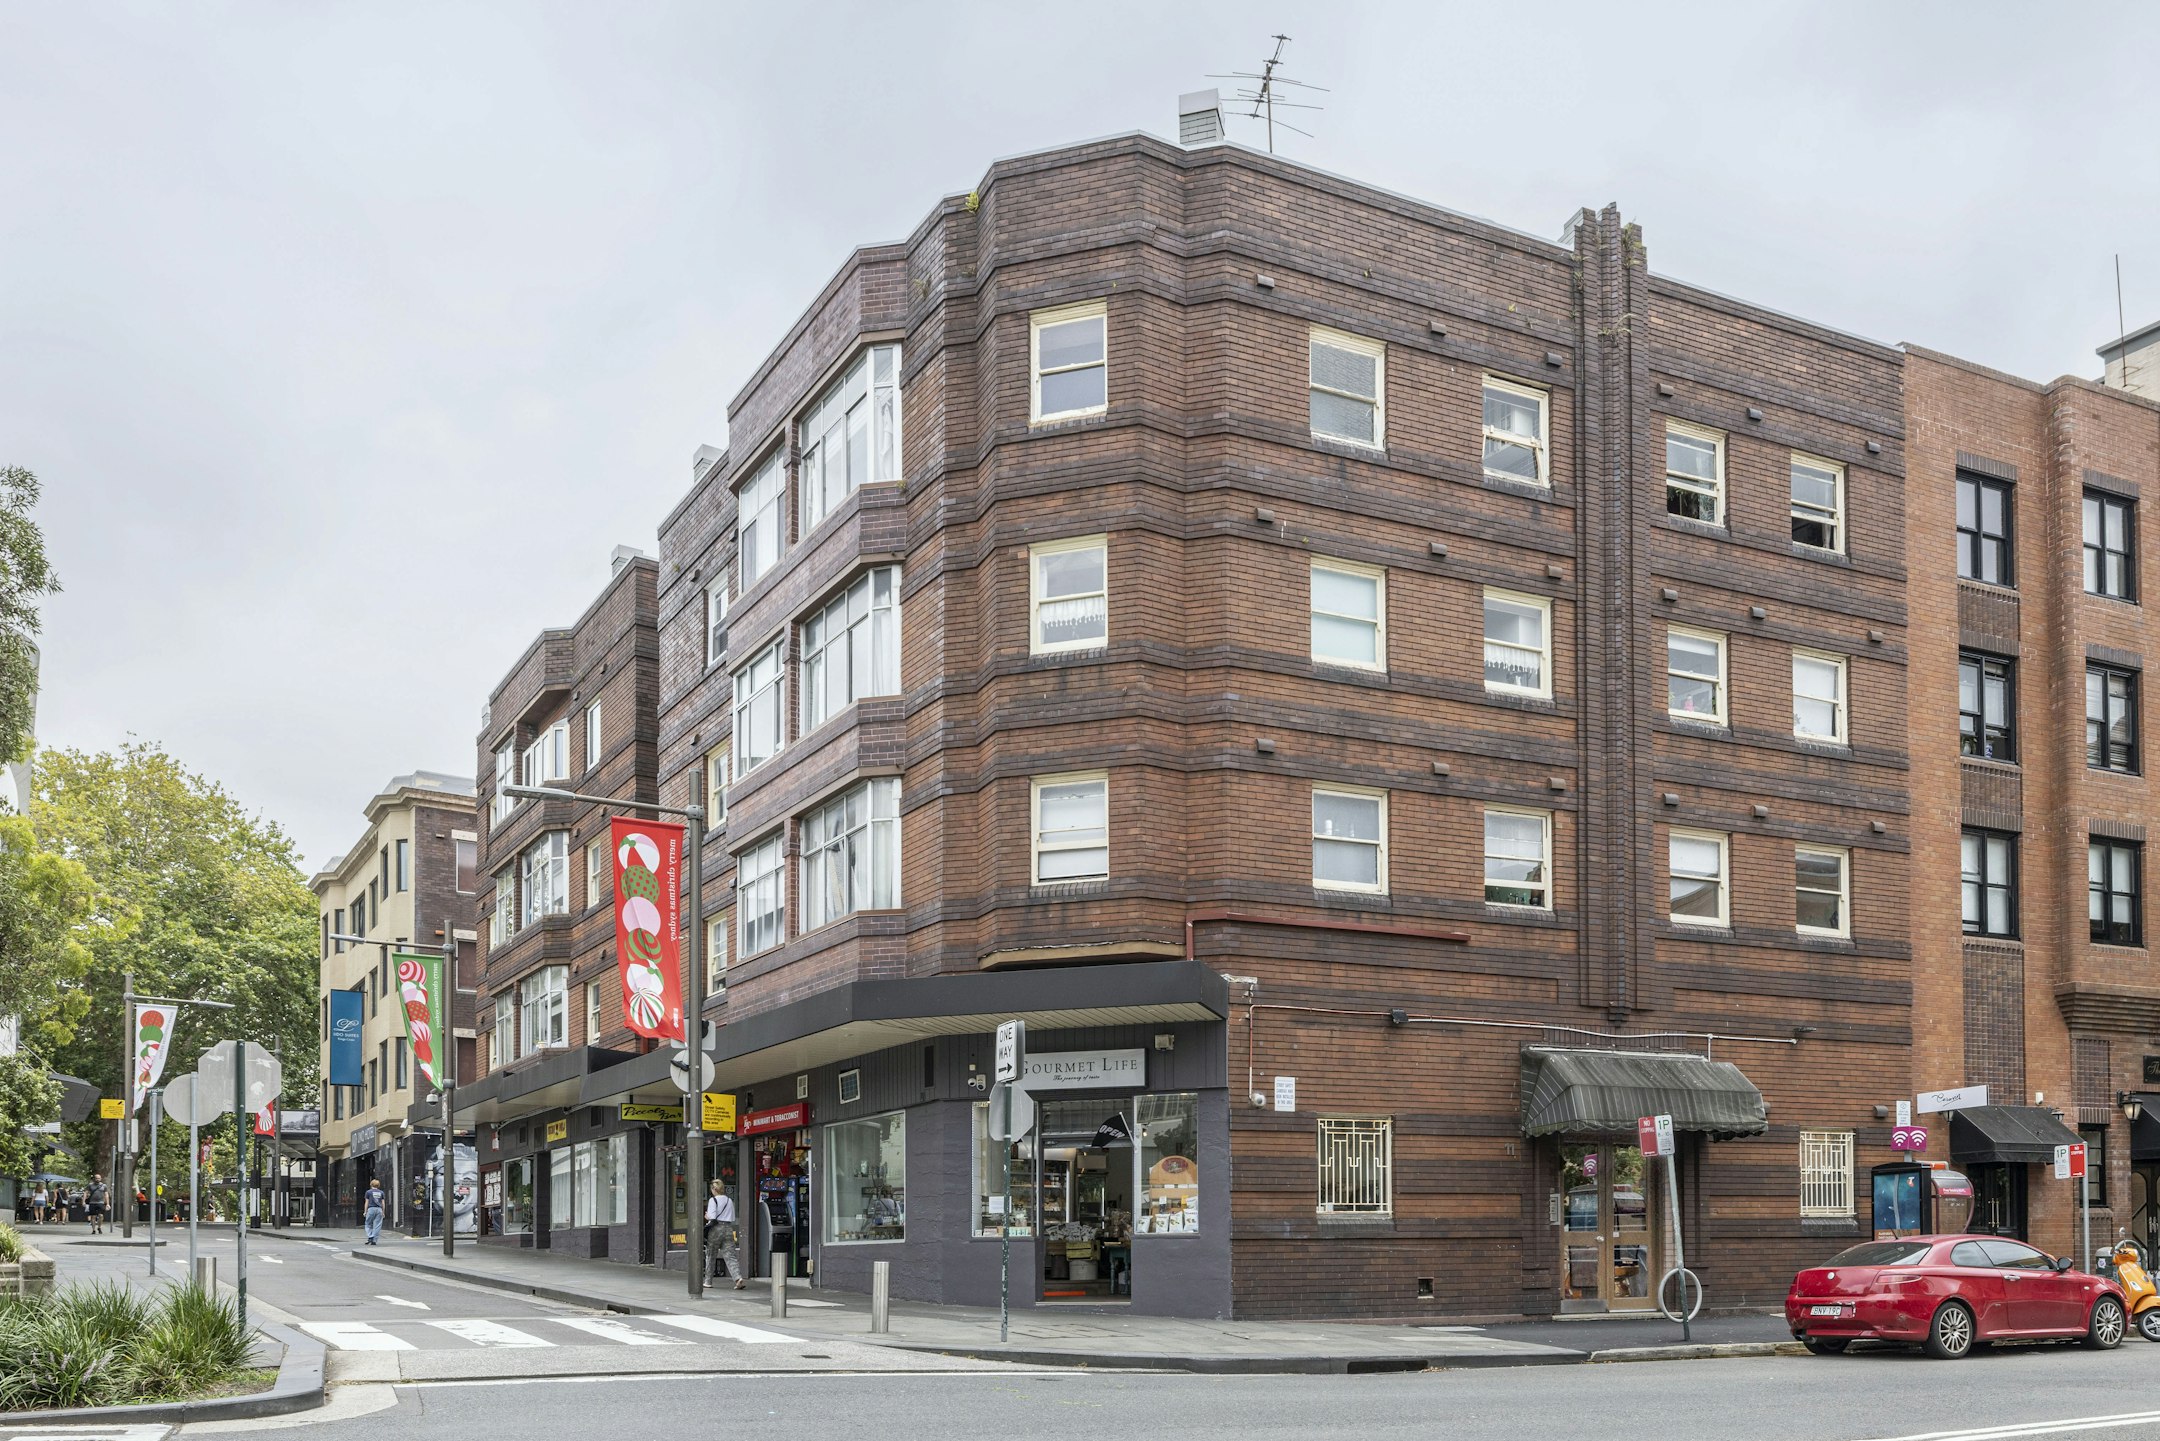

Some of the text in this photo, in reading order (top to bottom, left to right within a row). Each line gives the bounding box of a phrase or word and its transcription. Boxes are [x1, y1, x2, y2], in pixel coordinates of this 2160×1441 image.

[1000, 1027, 1012, 1042] ONE
[999, 1044, 1012, 1060] WAY
[623, 1106, 682, 1120] Piccolo Bar
[775, 1110, 799, 1122] TOBACCONIST
[1099, 1124, 1125, 1138] OPEN
[1658, 1120, 1669, 1130] 1P
[1504, 1143, 1515, 1156] 11
[2057, 1148, 2067, 1158] 1P
